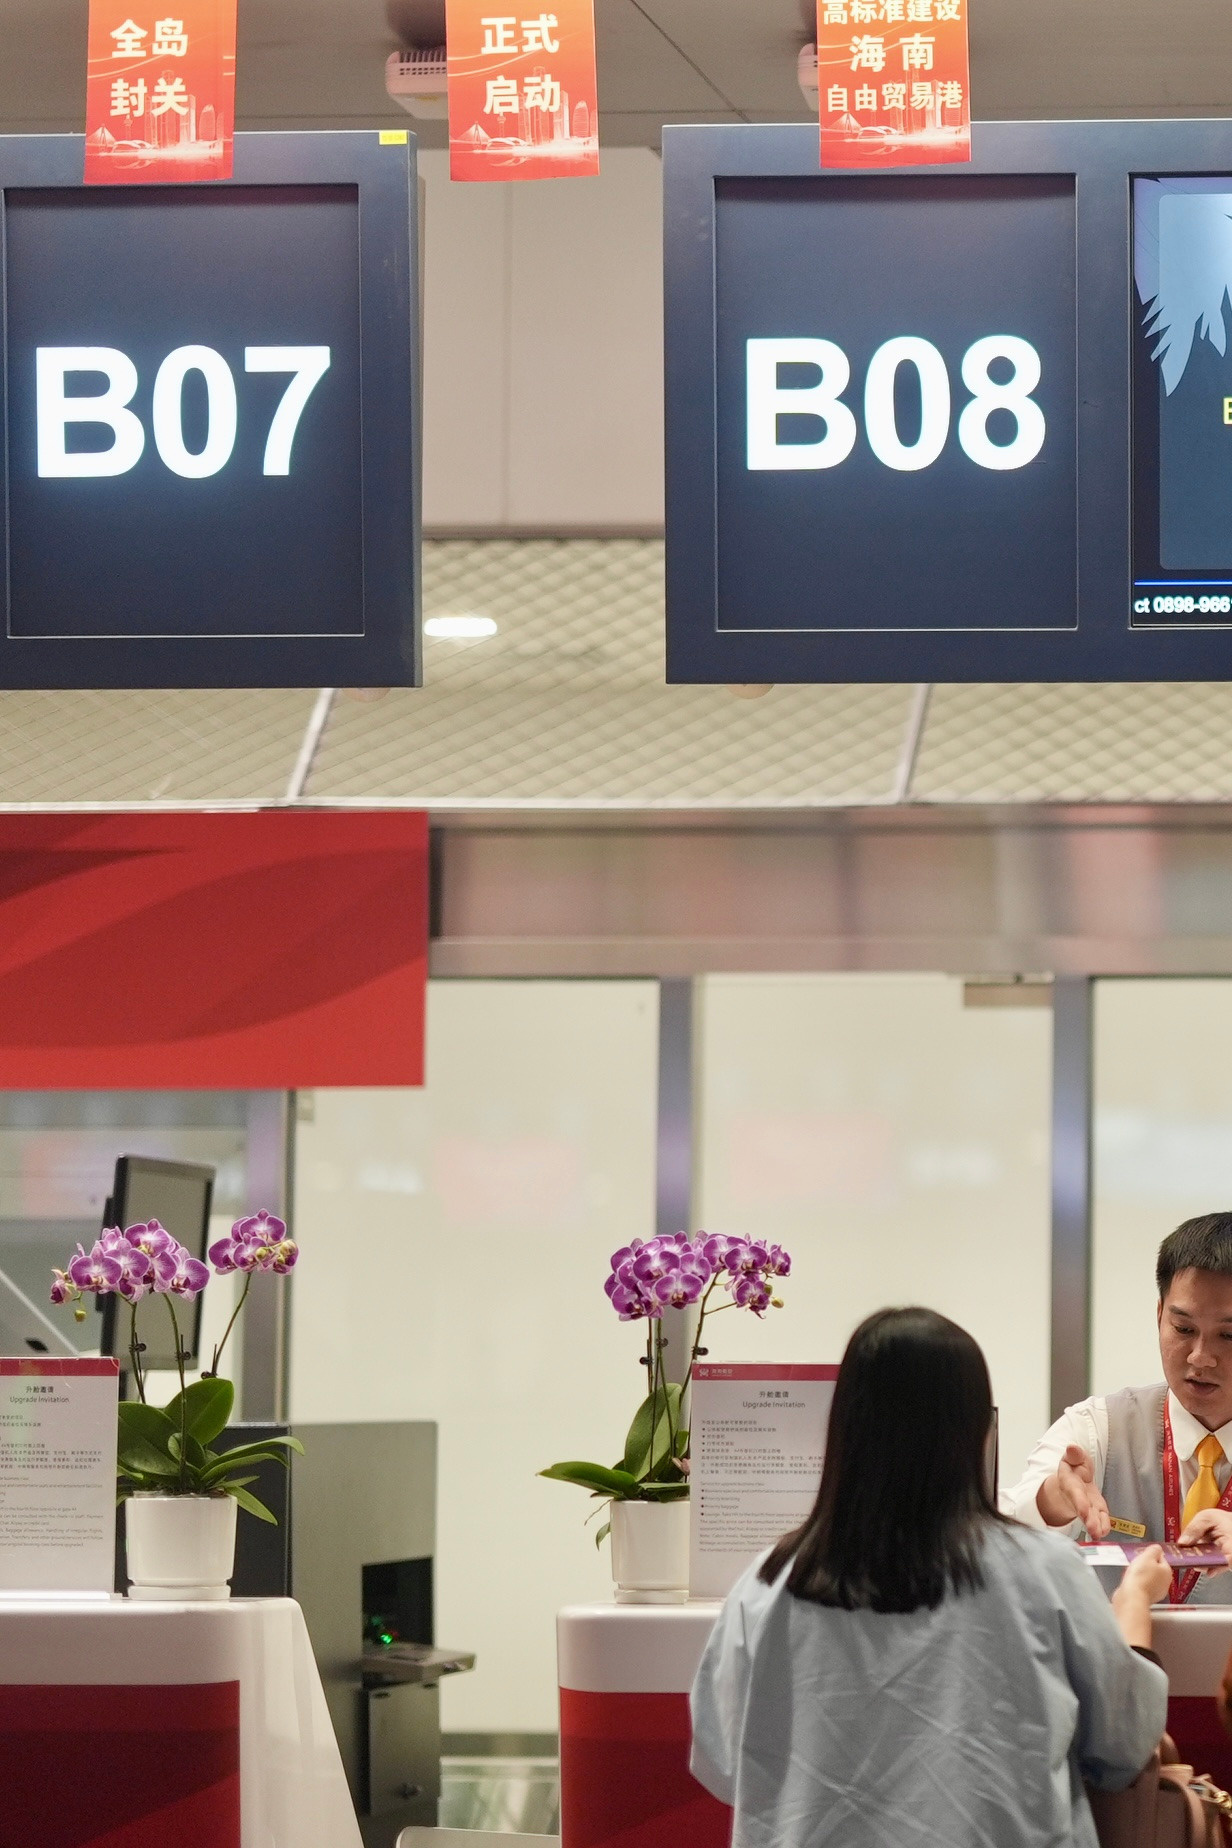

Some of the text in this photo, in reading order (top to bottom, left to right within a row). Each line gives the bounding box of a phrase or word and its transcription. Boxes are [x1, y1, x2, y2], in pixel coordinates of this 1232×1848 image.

[822, 0, 962, 25] 高标准建设
[109, 18, 189, 59] 全岛
[480, 13, 560, 55] 正式
[849, 33, 936, 72] 海南
[109, 77, 190, 118] 封关
[483, 74, 562, 116] 启动
[827, 80, 964, 113] 自由贸易港
[36, 344, 331, 479] B07
[746, 334, 1046, 471] B08
[742, 1401, 772, 1409] Upgrade
